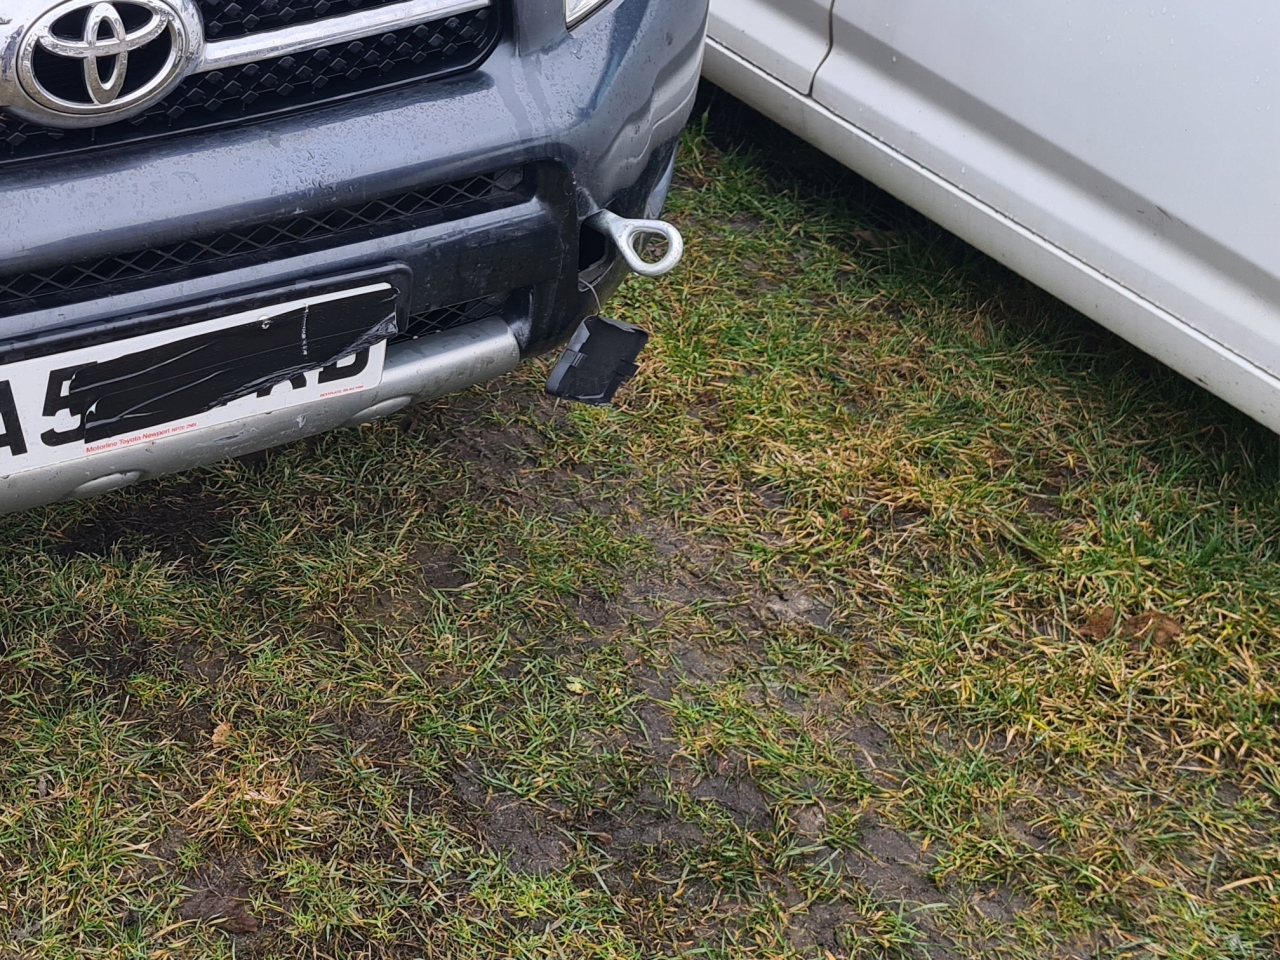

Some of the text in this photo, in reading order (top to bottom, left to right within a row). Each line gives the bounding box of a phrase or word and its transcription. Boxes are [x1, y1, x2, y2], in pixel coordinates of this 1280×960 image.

[85, 441, 118, 454] Motorline
[119, 436, 141, 446] Toyota
[142, 428, 171, 440] Newport
